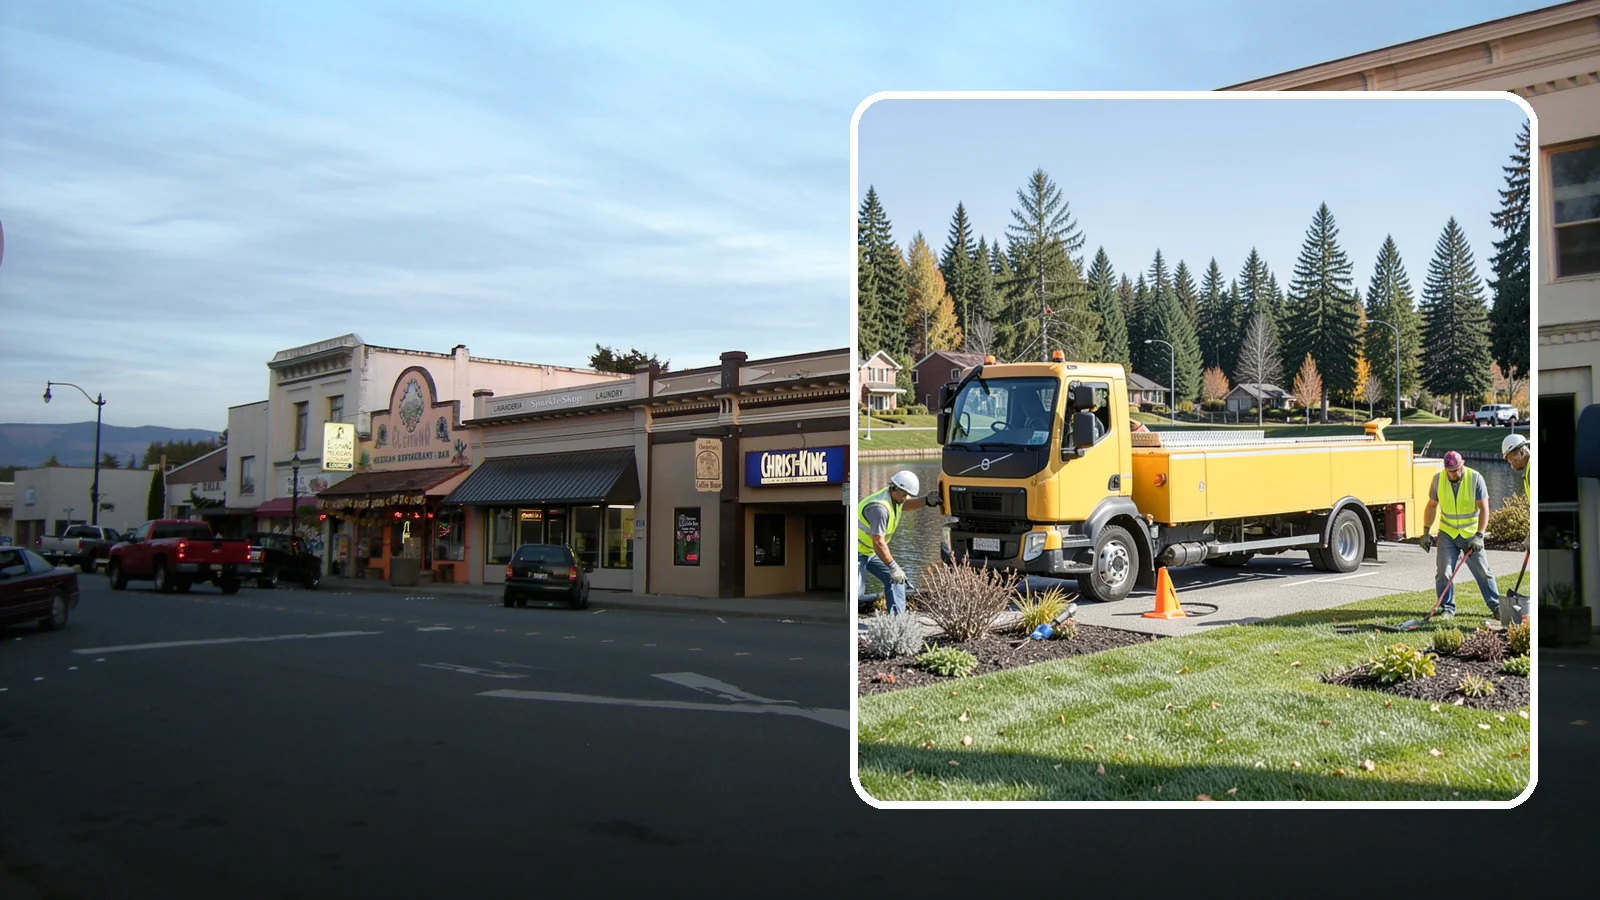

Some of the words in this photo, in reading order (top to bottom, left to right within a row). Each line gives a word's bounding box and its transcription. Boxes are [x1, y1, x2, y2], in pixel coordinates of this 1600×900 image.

[596, 389, 624, 400] LAUNDRY
[493, 402, 522, 413] LAVANDERIA
[531, 397, 561, 409] Sparkle
[562, 395, 582, 405] Shop
[373, 455, 396, 464] MEXICAN
[397, 451, 433, 463] RESTAURANT
[438, 450, 450, 459] BAR
[799, 450, 827, 477] KING
[697, 481, 709, 489] Coffee
[710, 481, 722, 489] House
